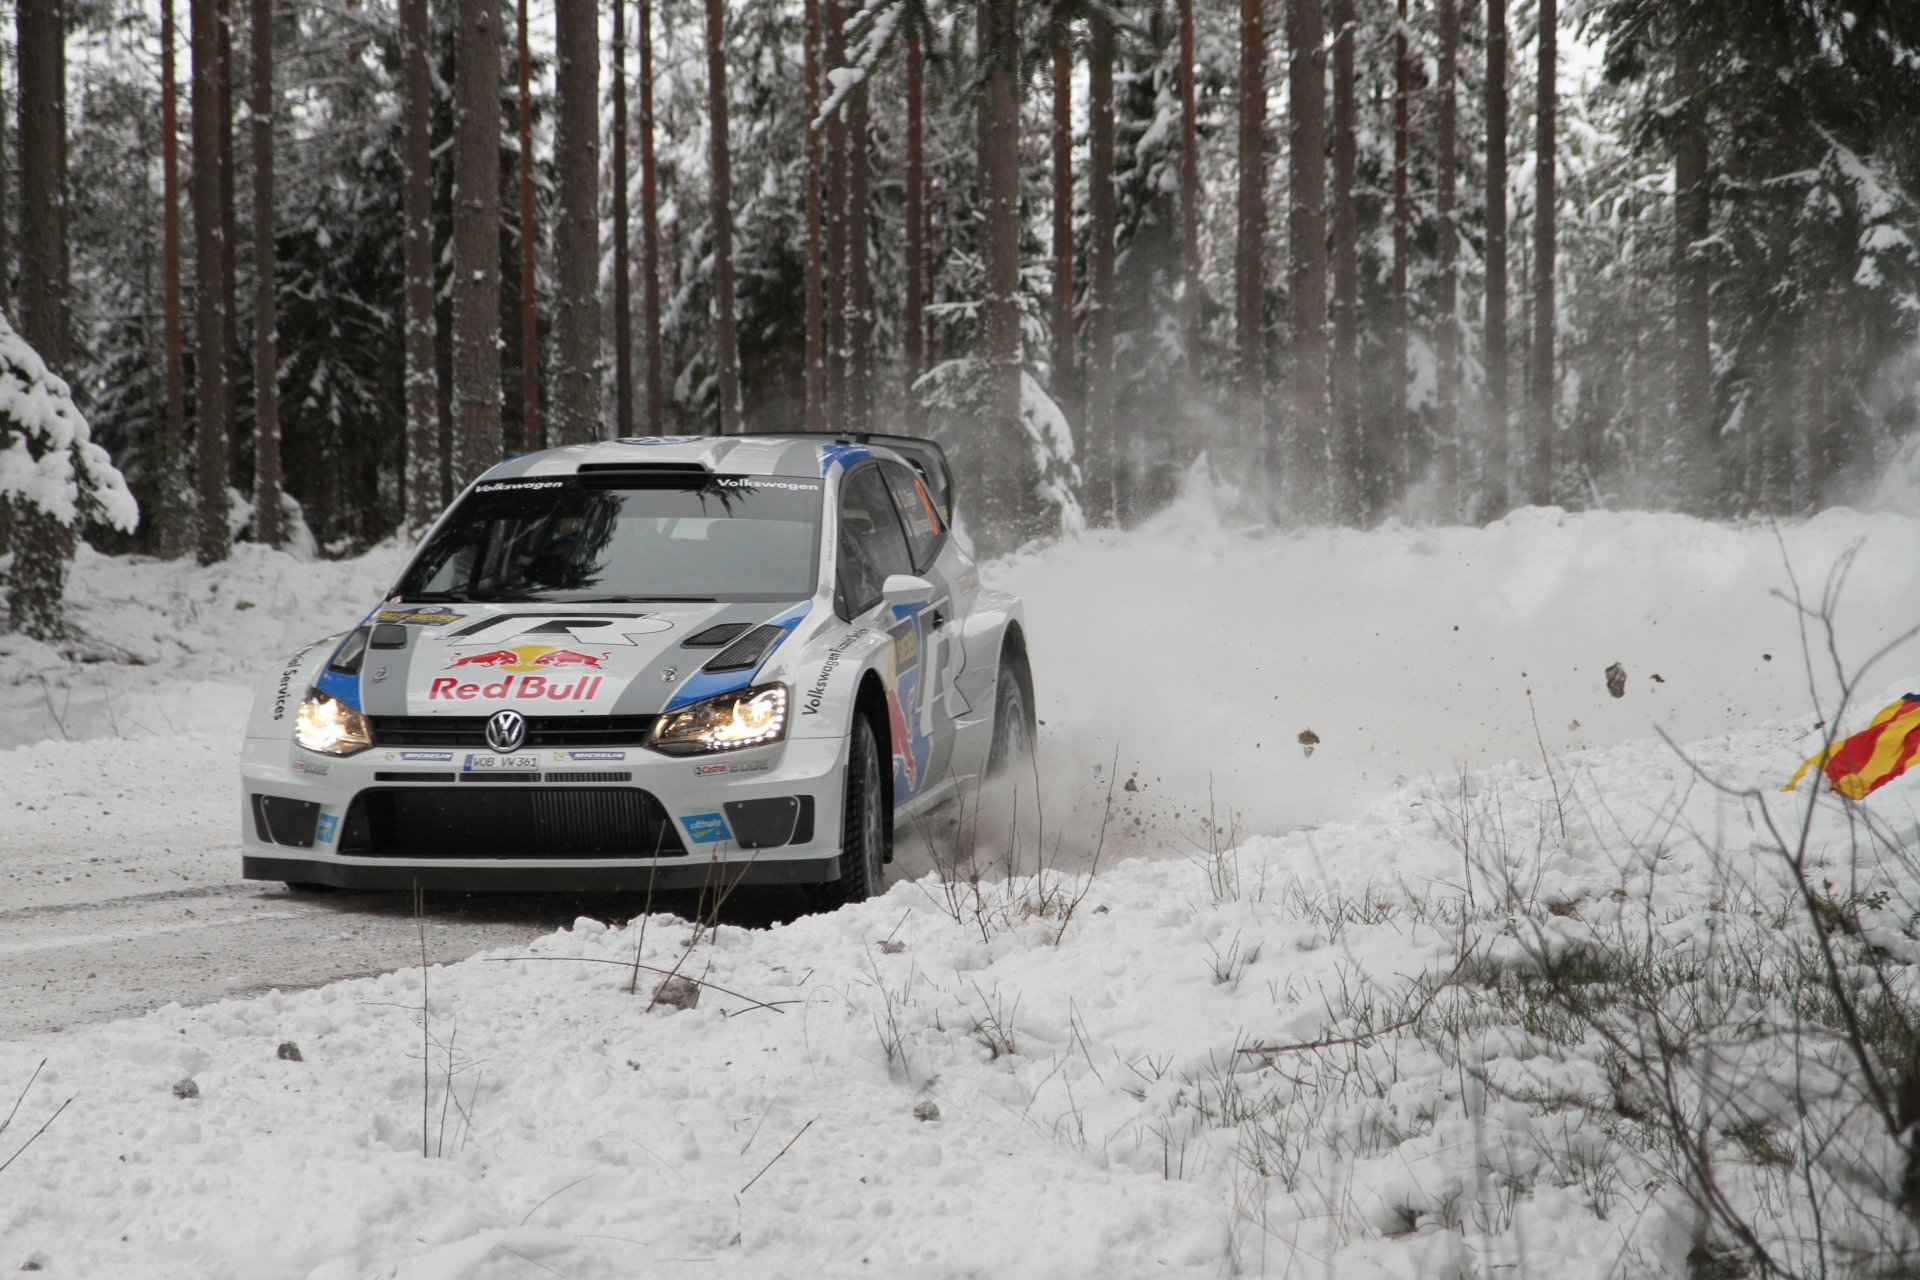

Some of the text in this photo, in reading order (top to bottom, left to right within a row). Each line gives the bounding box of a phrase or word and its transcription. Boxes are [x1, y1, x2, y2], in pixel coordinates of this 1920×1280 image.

[474, 480, 563, 493] Volkswagen
[716, 478, 819, 491] Volkswagen
[428, 675, 603, 701] Red Bull
[802, 652, 840, 715] Volkswagen
[273, 669, 298, 721] Services
[402, 752, 452, 760] MICHELIN
[473, 757, 537, 767] WOB VW 361
[573, 752, 624, 760] MICHELIN
[702, 764, 727, 775] Castrol
